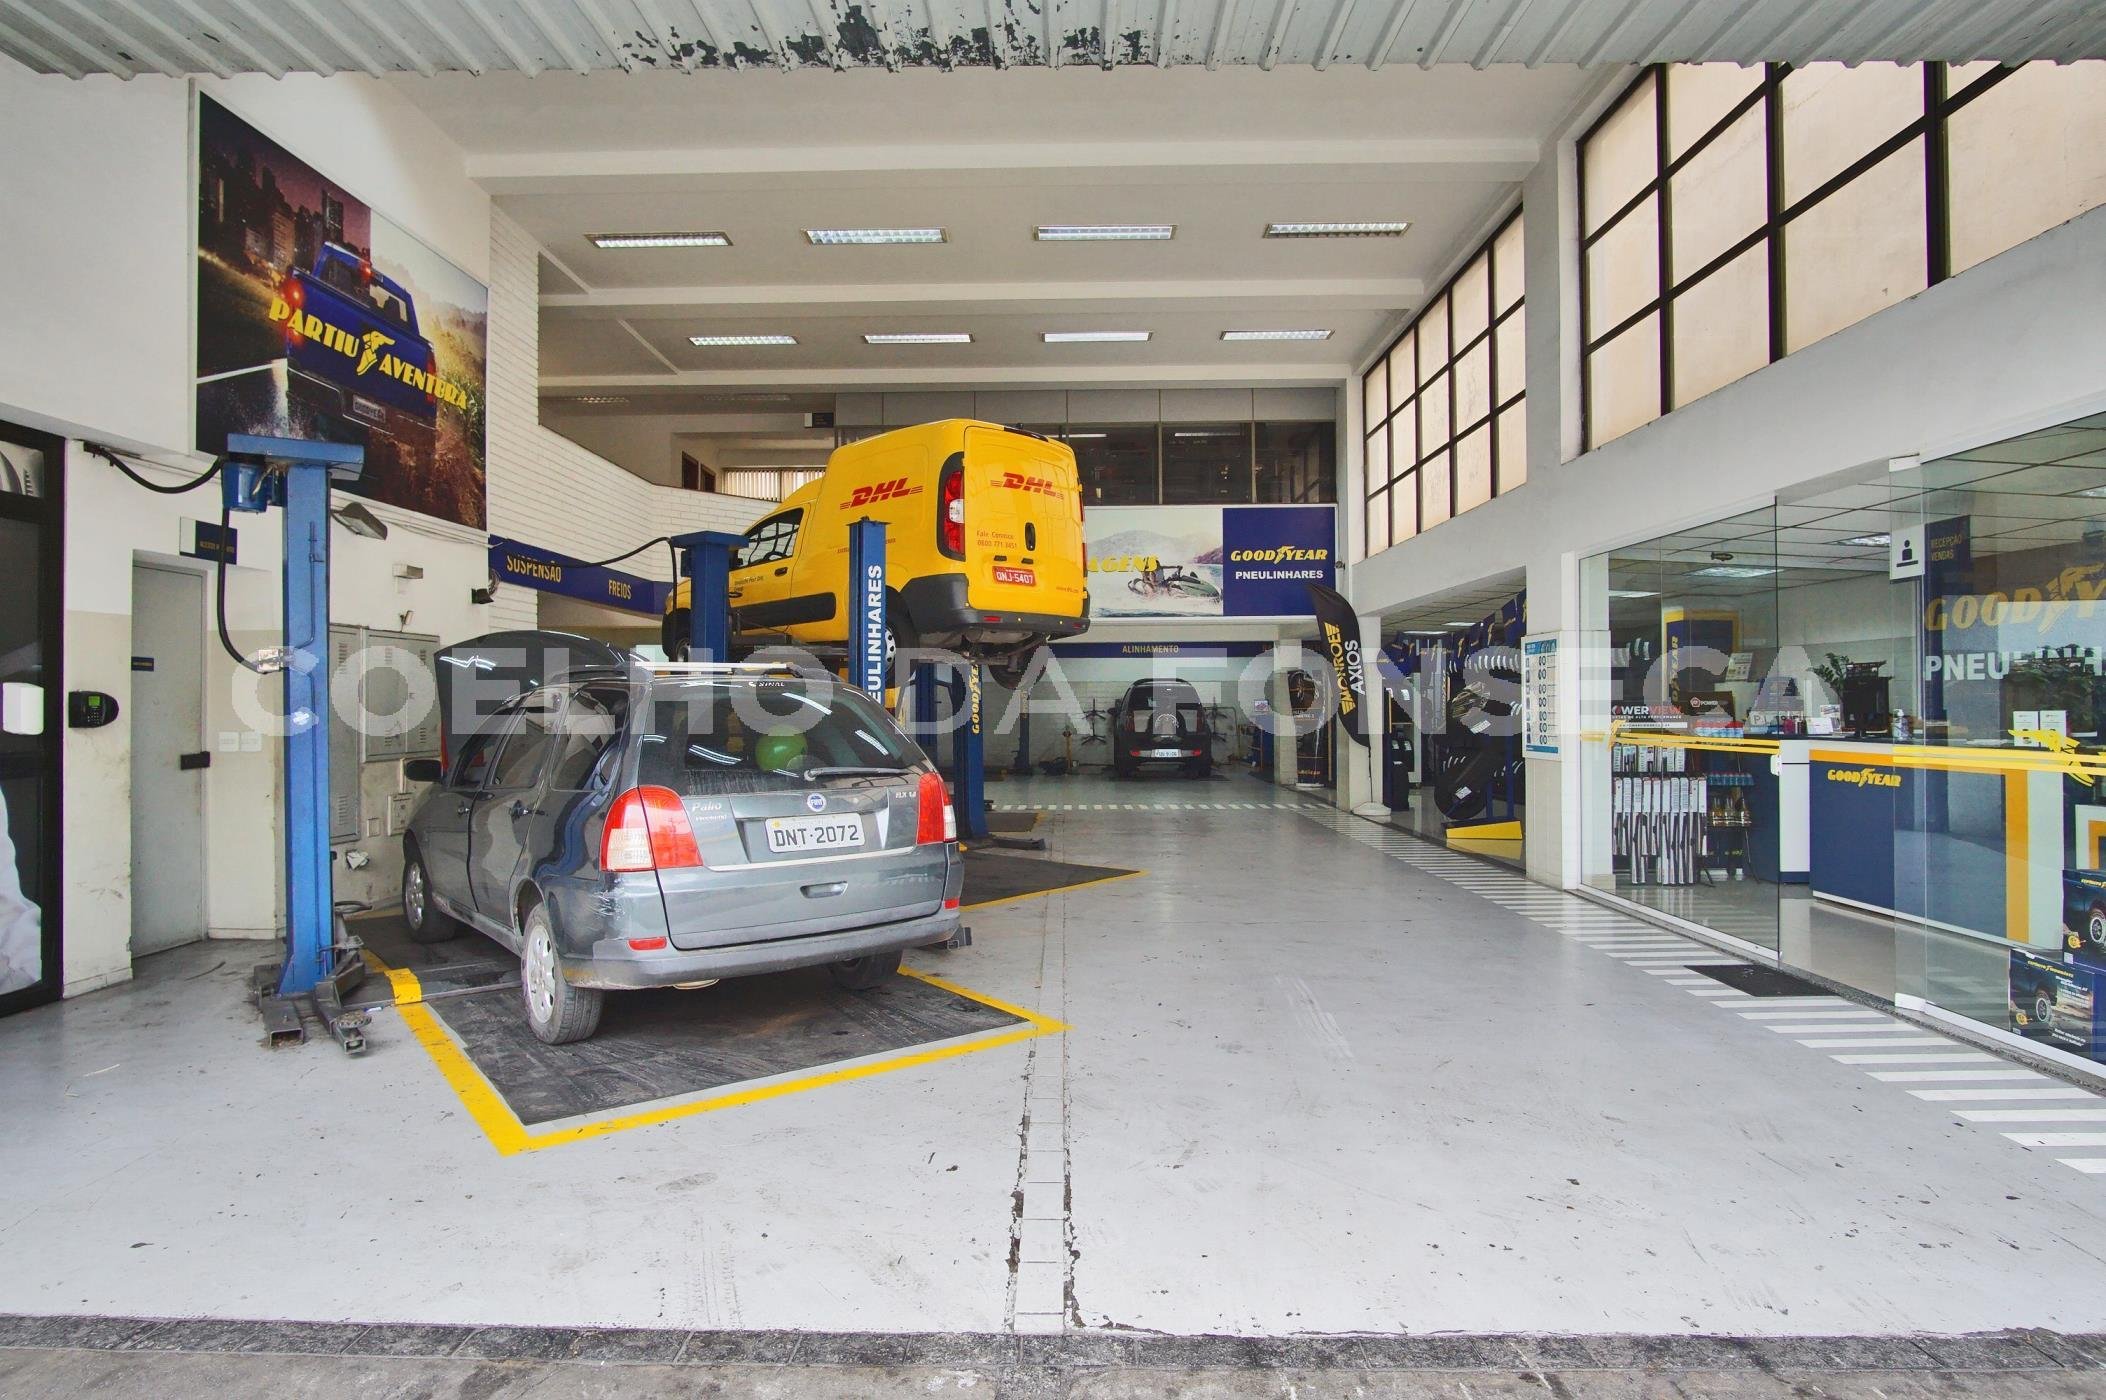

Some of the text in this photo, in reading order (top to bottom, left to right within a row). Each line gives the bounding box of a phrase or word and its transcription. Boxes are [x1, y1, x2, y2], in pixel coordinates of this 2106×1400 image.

[269, 299, 467, 410] PARTIU AVENTURA
[848, 476, 912, 508] DHL
[1001, 472, 1058, 498] DHL
[1230, 547, 1328, 563] GOODYEAR
[1235, 569, 1324, 580] PNEULINHARES
[608, 579, 632, 600] FREIOS
[1122, 644, 1179, 653] ALINHAMENTO
[1327, 630, 1353, 704] MONROE
[1344, 640, 1366, 695] AXIOS
[1828, 768, 1901, 787] GOODYEAR
[692, 800, 722, 812] Palio
